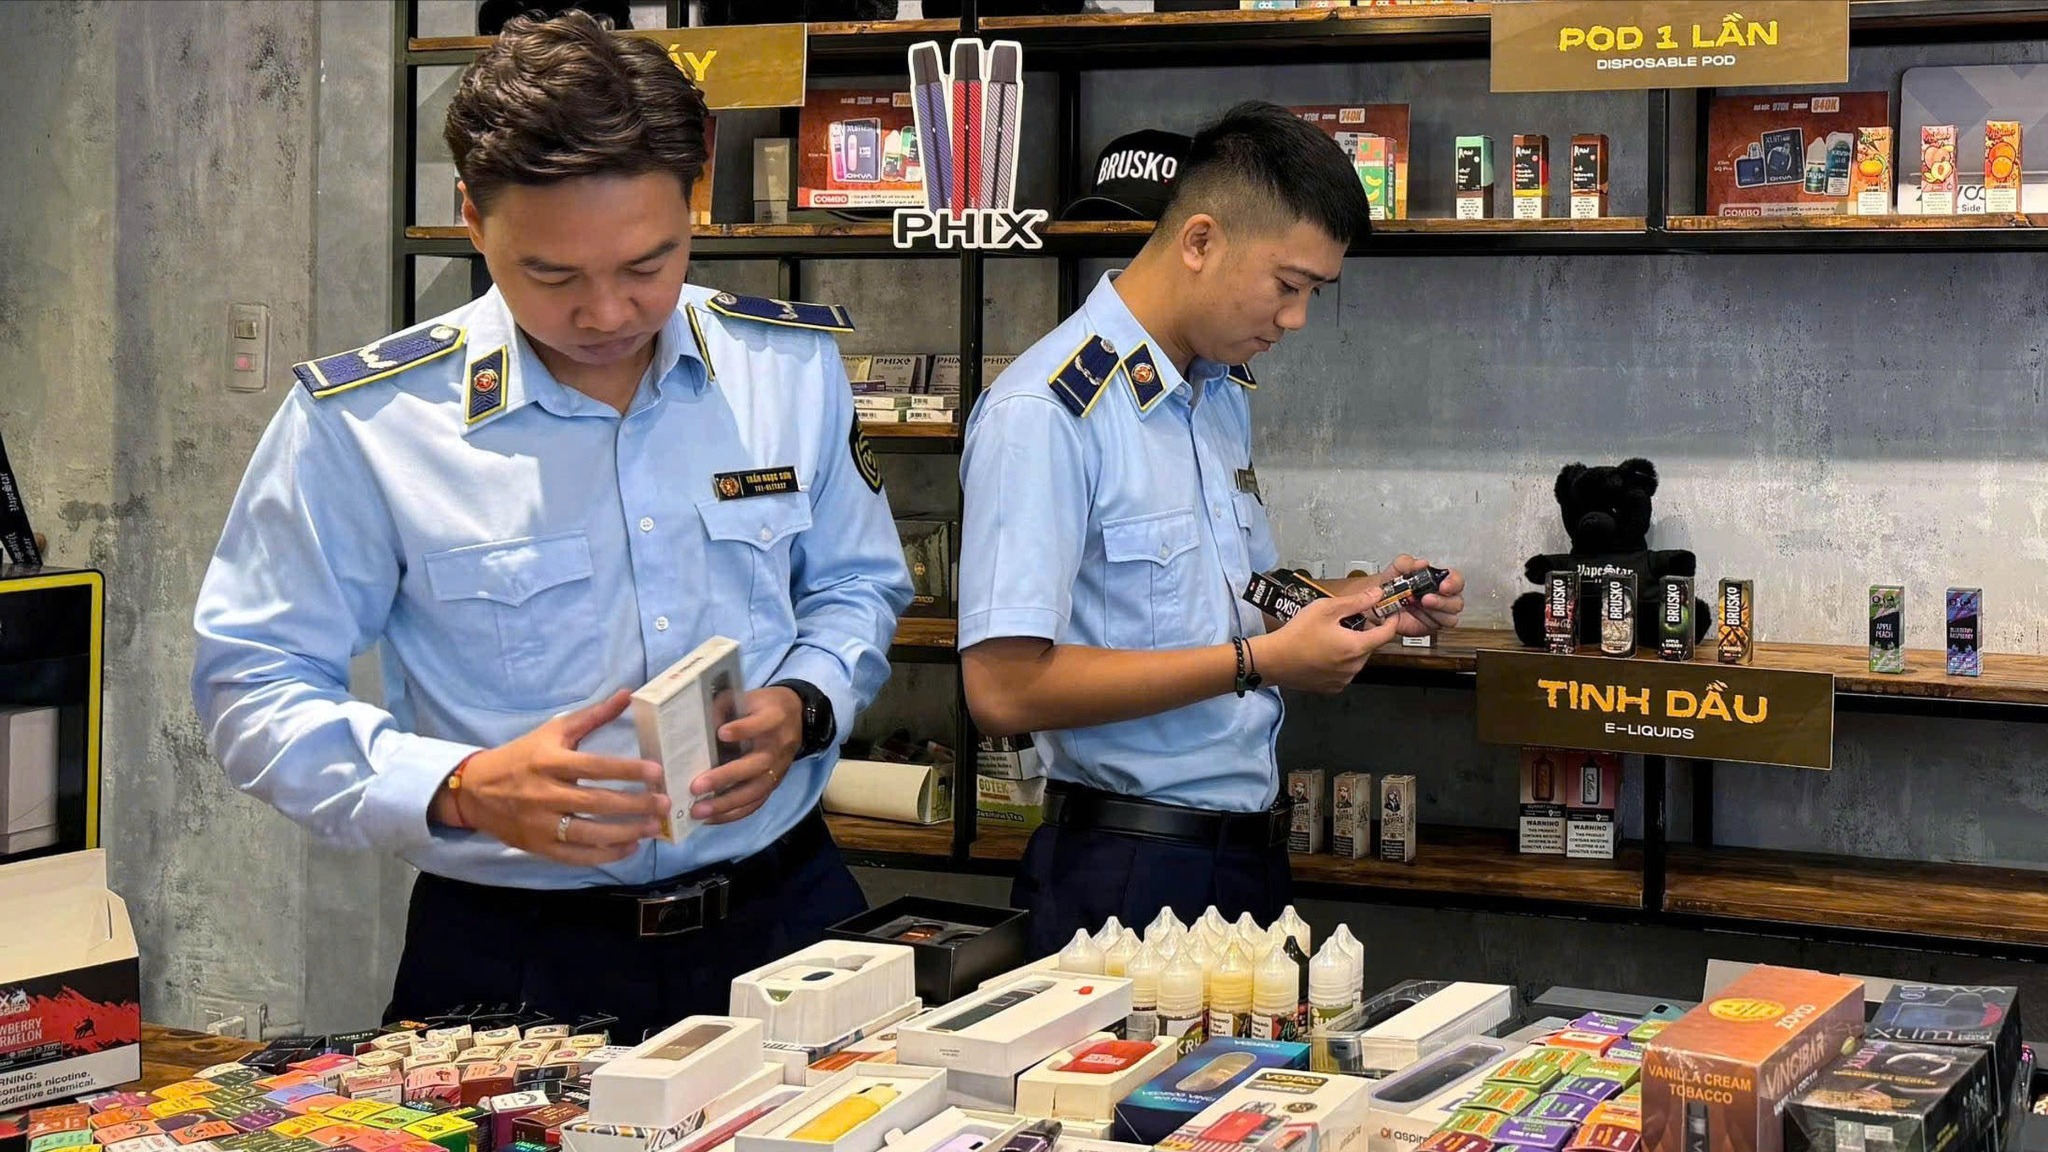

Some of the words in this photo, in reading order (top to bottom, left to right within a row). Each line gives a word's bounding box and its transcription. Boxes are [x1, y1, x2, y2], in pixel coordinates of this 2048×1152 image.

[1559, 25, 1644, 52] POD
[1656, 25, 1678, 49] 1
[1693, 12, 1779, 49] LẦN
[1596, 56, 1697, 71] DISPOSABLE
[1702, 54, 1736, 67] POD
[1097, 149, 1178, 186] BRUSKO
[814, 195, 848, 204] COMBO
[1961, 203, 1981, 213] Side
[898, 212, 1041, 246] PHIX
[875, 357, 906, 366] PHIX
[1552, 579, 1566, 617] BRUSKO
[1609, 581, 1623, 619] BRUSKO
[1667, 584, 1680, 622] BRUSKO
[1726, 586, 1740, 626] BRUSKO
[1875, 630, 1894, 638] PEACH
[1537, 678, 1651, 716] TINH
[1666, 679, 1769, 725] DẦU
[1604, 722, 1696, 740] E-LIQUIDS
[1871, 1027, 1953, 1041] XLIM
[45, 1071, 91, 1086] nicotine.
[46, 1078, 96, 1096] chemical.
[1649, 1065, 1701, 1084] VANILLA
[1704, 1073, 1752, 1092] CREAM
[1669, 1084, 1733, 1105] TOBACCO
